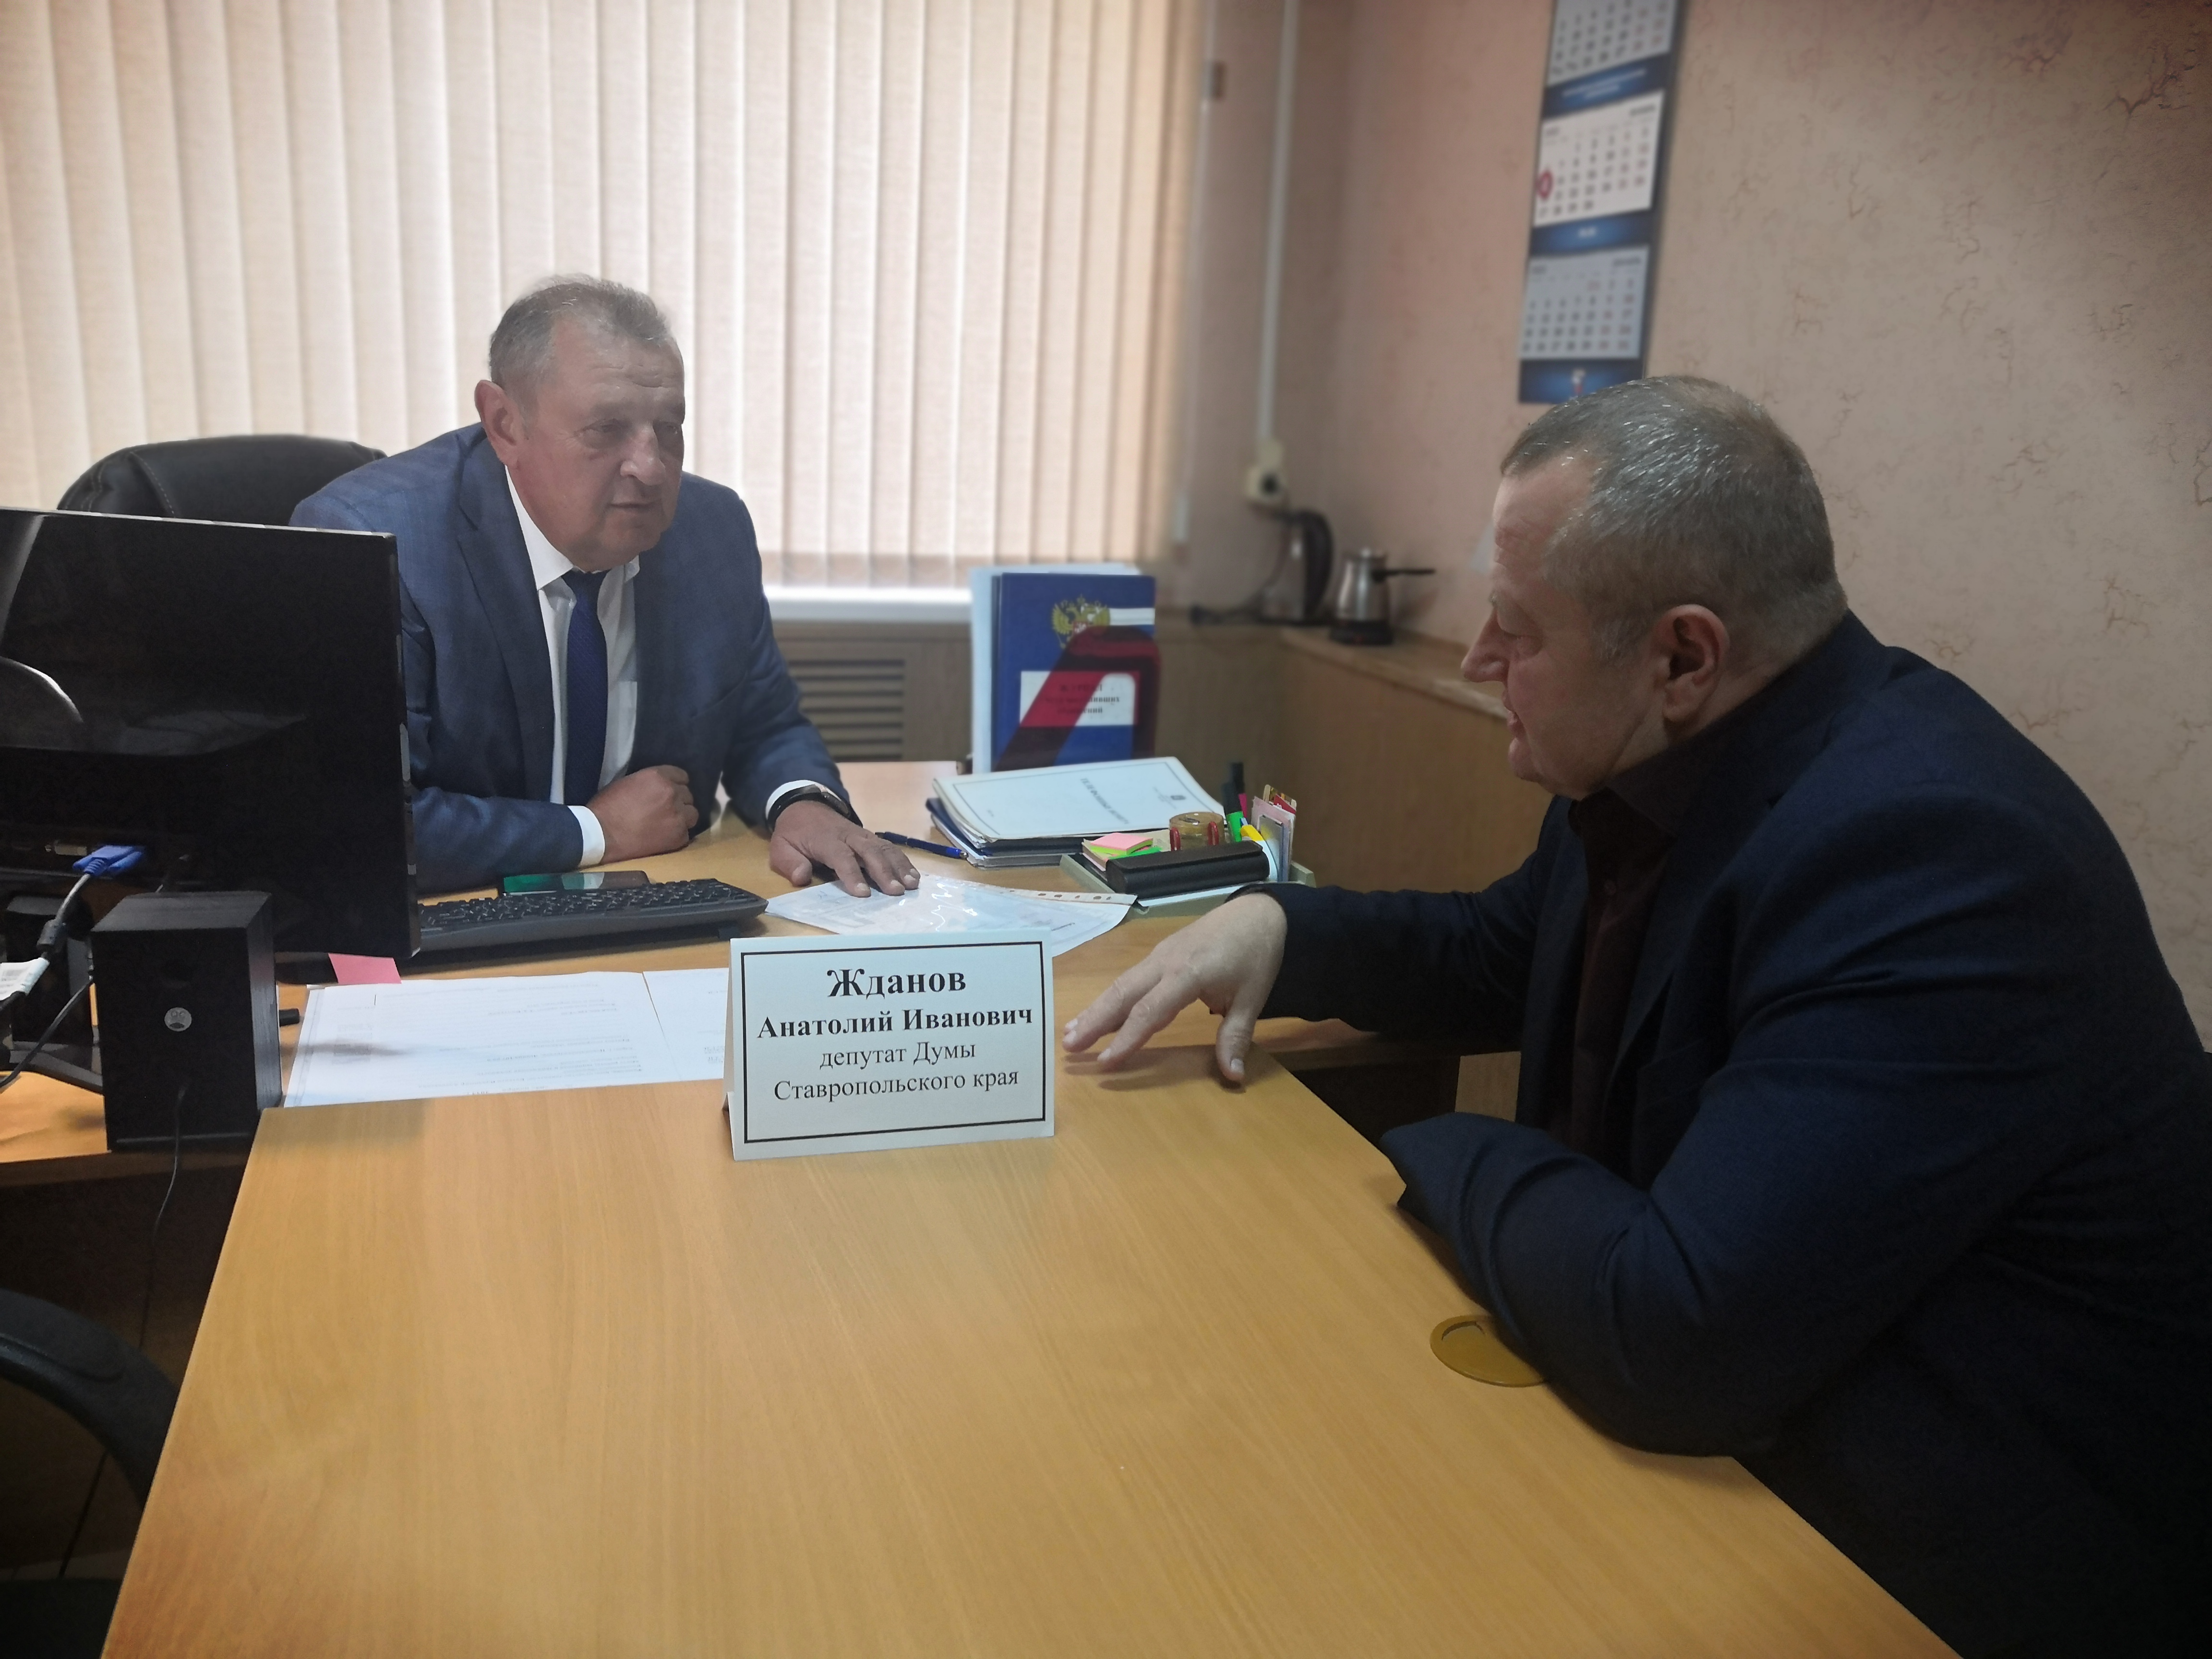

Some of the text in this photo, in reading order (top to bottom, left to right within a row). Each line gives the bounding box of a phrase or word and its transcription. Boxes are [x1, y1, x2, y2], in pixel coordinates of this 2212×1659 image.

[827, 968, 966, 999] Жданов
[757, 1008, 1033, 1038] Анатолий Иванович
[819, 1041, 976, 1070] депутат Думы
[774, 1071, 1019, 1103] Ставропольского края
